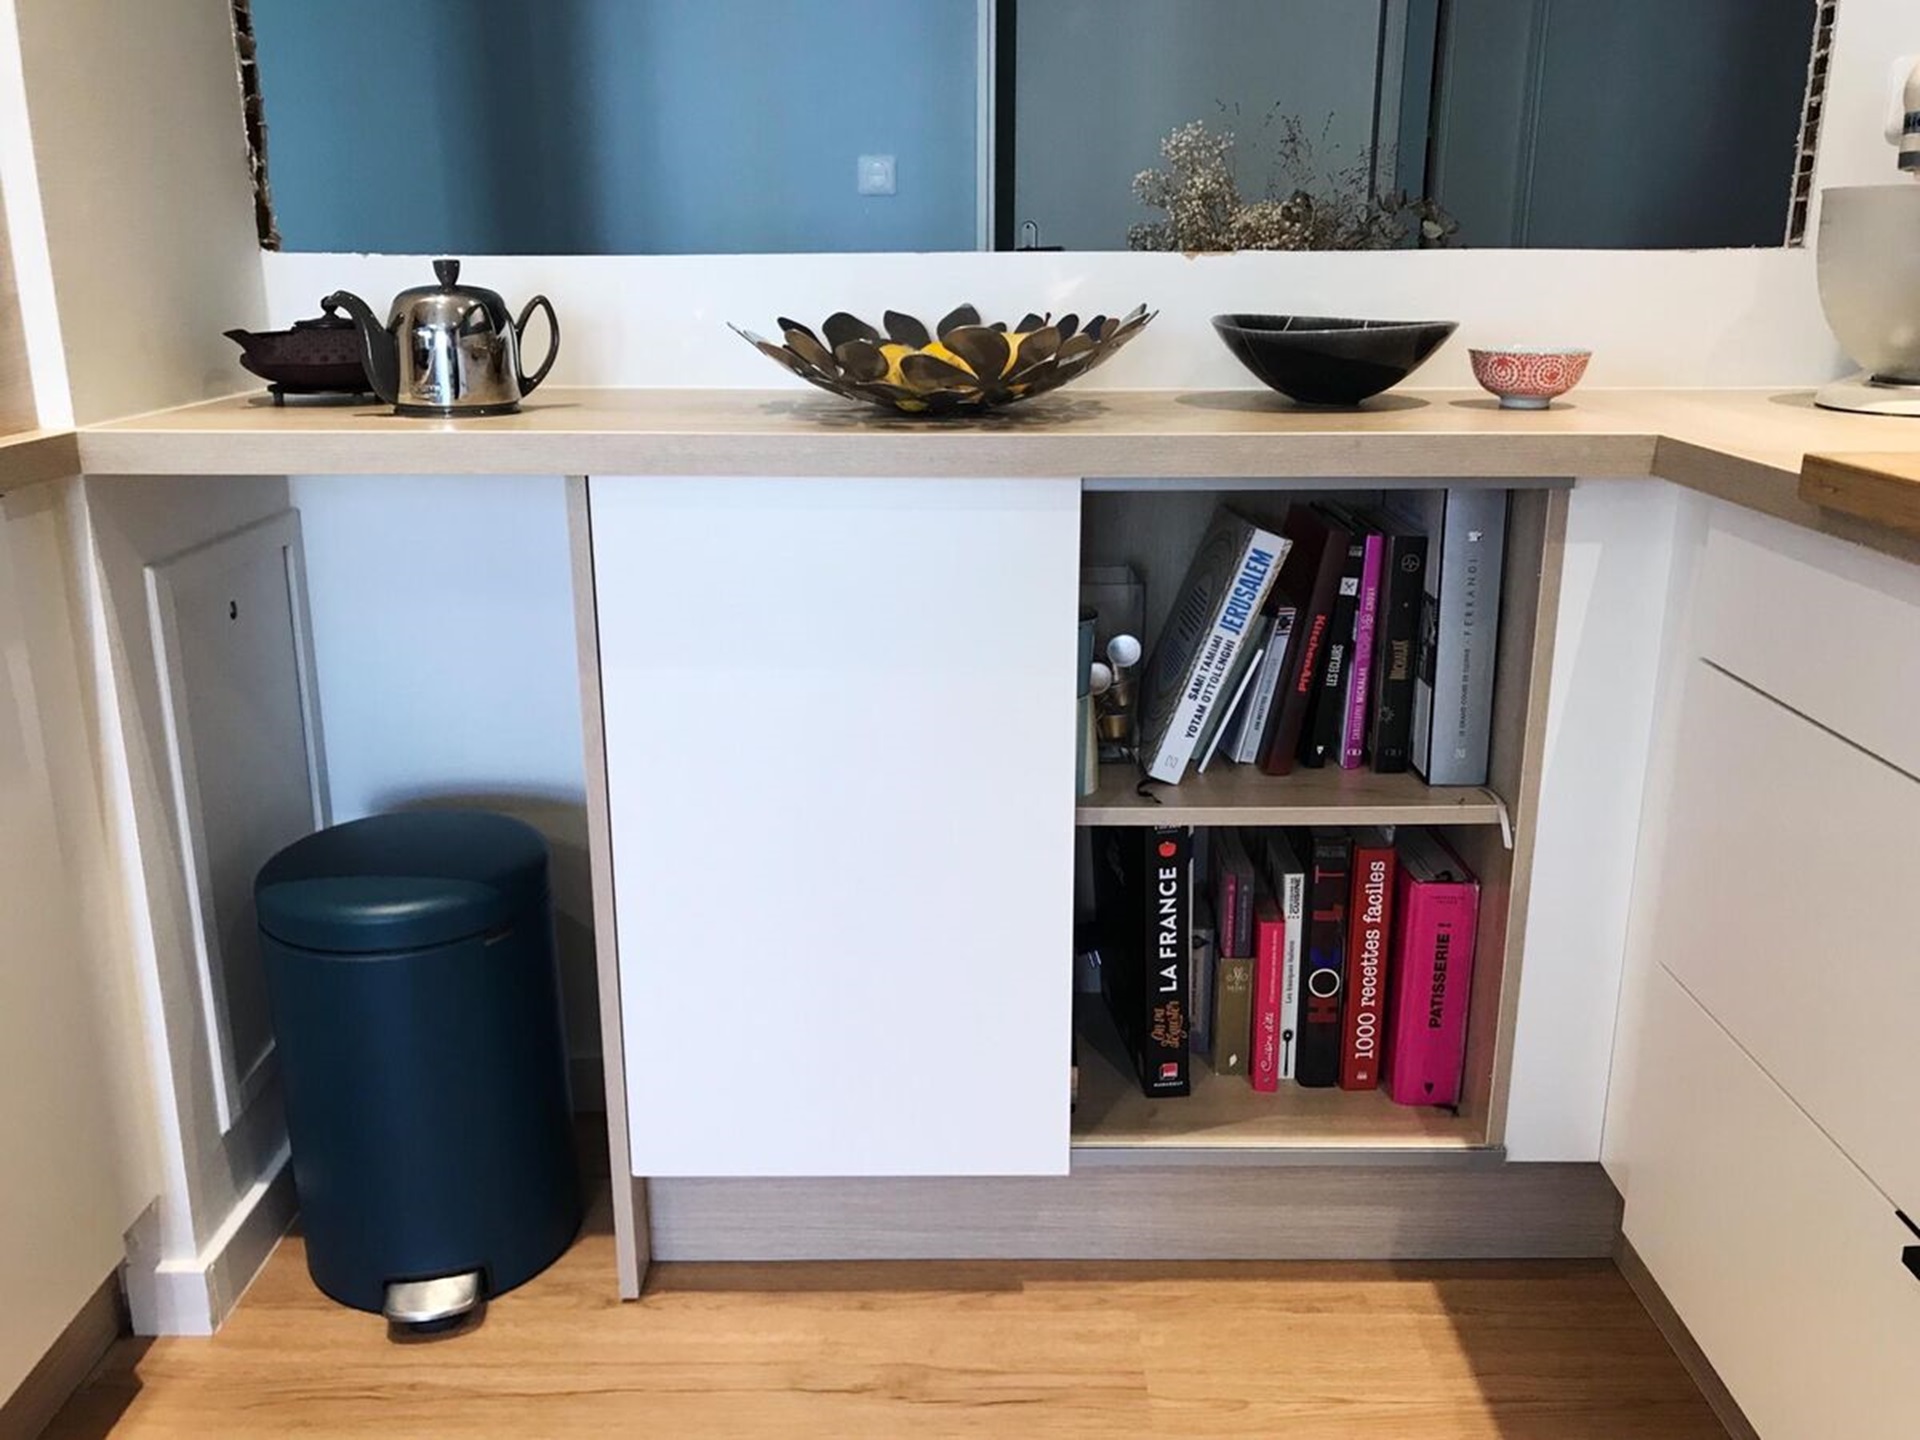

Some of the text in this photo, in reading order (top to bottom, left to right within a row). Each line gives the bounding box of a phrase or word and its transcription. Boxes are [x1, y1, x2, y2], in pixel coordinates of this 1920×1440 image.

[1219, 548, 1273, 636] JERUSALEM
[1185, 639, 1236, 739] YOTAM OTTOLENGHI
[1187, 635, 1223, 701] SAMI TAMIMI
[1297, 614, 1327, 692] KitchenAid
[1326, 672, 1339, 687] LES
[1158, 867, 1178, 992] LA FRANCE
[1292, 877, 1301, 914] CUISINE
[1354, 861, 1385, 1060] 1000 recettes faciles
[1428, 933, 1450, 1029] PATISSERIE
